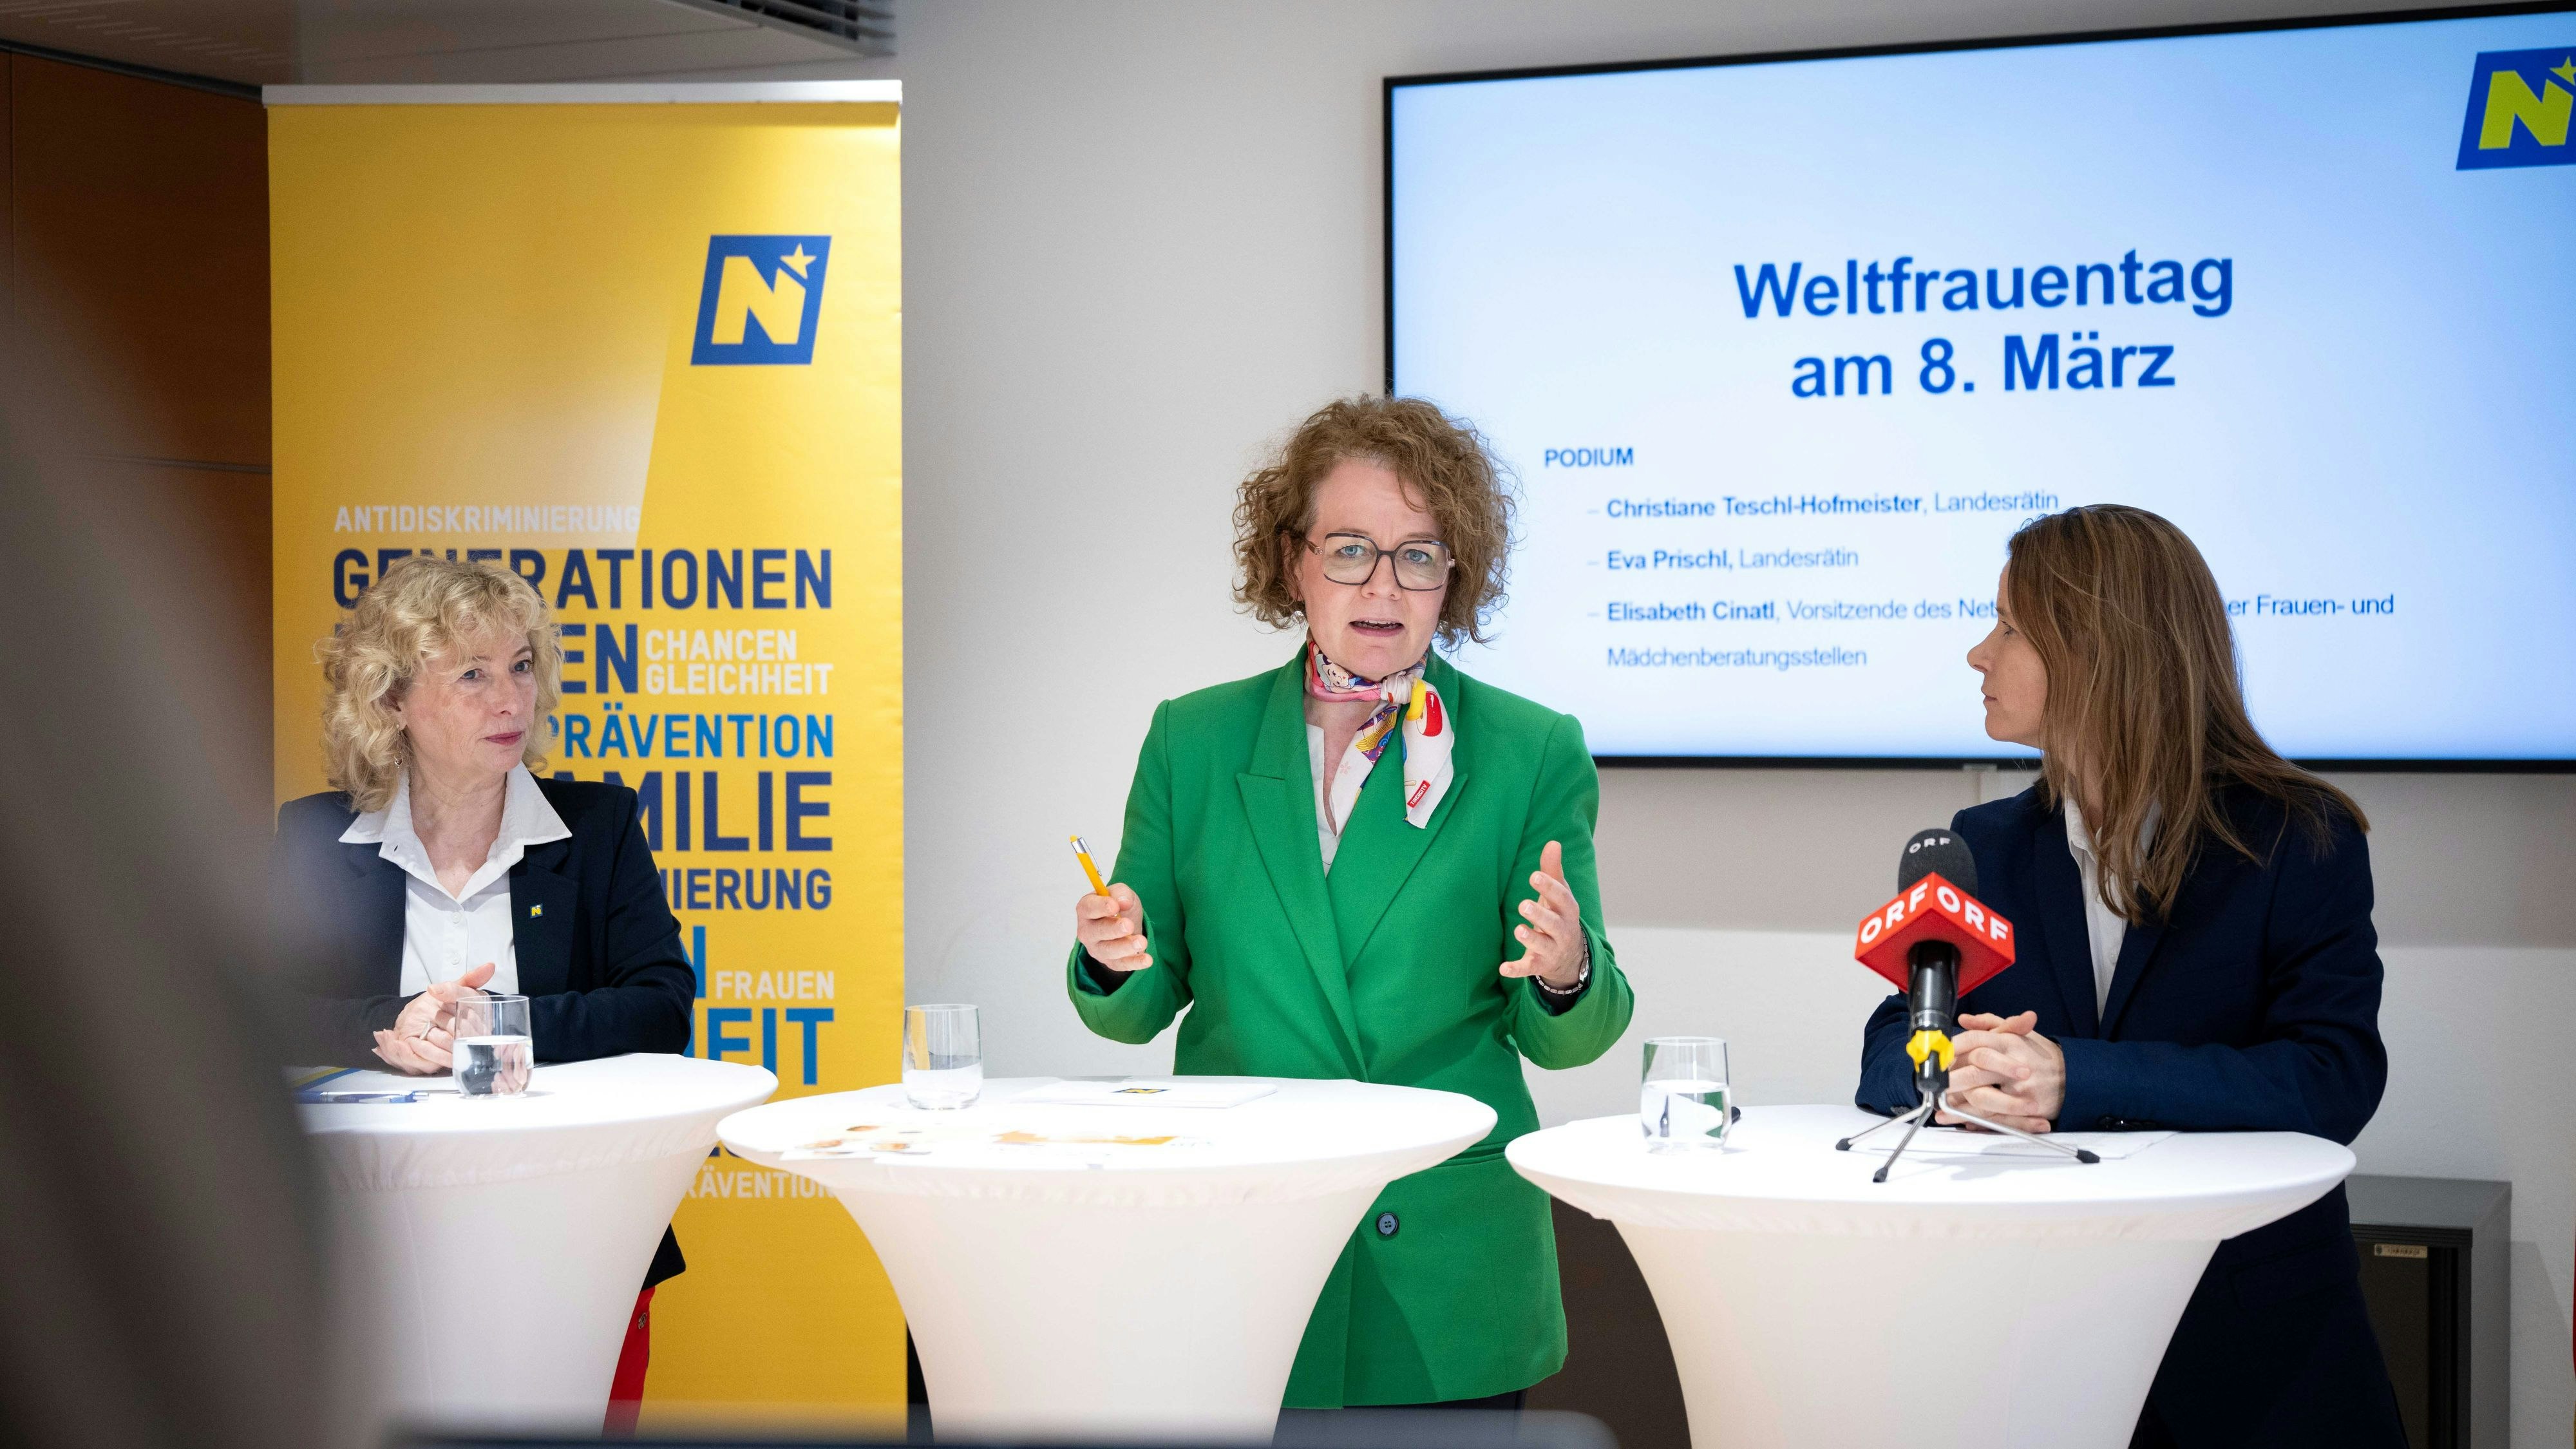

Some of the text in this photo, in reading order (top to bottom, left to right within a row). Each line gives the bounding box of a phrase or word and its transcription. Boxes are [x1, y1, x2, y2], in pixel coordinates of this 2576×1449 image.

[1734, 248, 2233, 319] Weltfrauentag
[1791, 330, 2176, 399] am 8. März
[1545, 447, 1634, 468] PODIUM
[334, 505, 641, 533] ANTIDISKRIMINIERUNG
[1607, 491, 2059, 518] Christiane Teschl-Hofmeister, Landesrätin
[1607, 547, 1859, 573] Eva Prischl, Landesrätin
[333, 549, 831, 610] GRATIONEN
[1608, 601, 1706, 621] Elisabeth
[1712, 600, 1781, 623] Cinatl,
[1786, 599, 1908, 620] Vorsitzende
[1914, 598, 1953, 619] des
[1959, 598, 1997, 619] Net
[2257, 594, 2345, 616] Frauen-
[2352, 593, 2394, 615] und
[646, 629, 797, 661] CHANCEN
[1607, 646, 1868, 672] Mädchenberatungsstellen
[646, 663, 834, 695] GLEICHHEIT
[553, 771, 833, 851] MILIE
[1908, 837, 1951, 854] ORF
[1861, 882, 1928, 944] ORF
[1937, 885, 2009, 941] ORF
[715, 971, 835, 999] FRAUEN
[685, 1166, 837, 1198] ÄVENTIO
